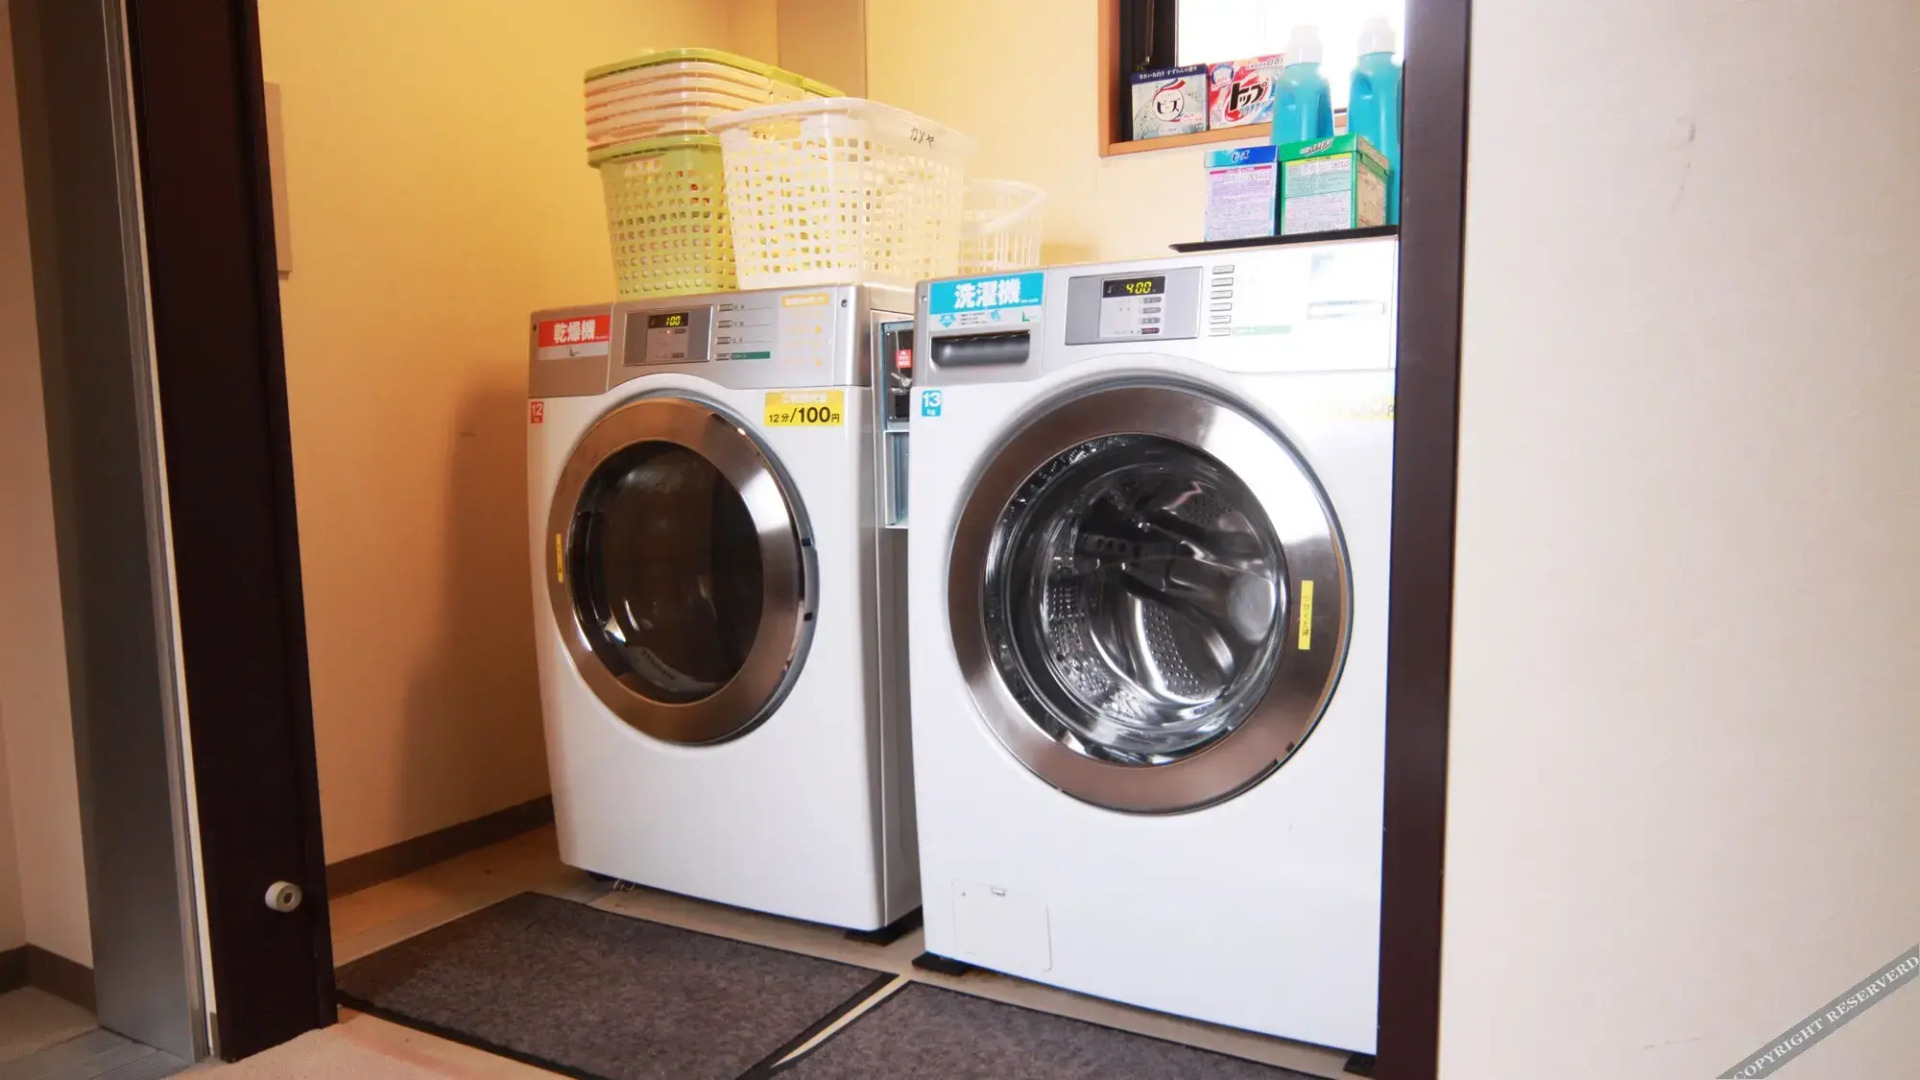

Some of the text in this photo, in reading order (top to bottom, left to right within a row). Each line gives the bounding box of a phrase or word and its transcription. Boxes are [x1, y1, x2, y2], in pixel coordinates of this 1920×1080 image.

[1230, 80, 1268, 111] トップ
[954, 278, 1021, 309] 洗濯機
[1126, 281, 1152, 294] 400
[666, 315, 681, 326] 100
[553, 319, 596, 344] 乾燥機
[922, 392, 941, 407] 13
[532, 403, 543, 416] 12
